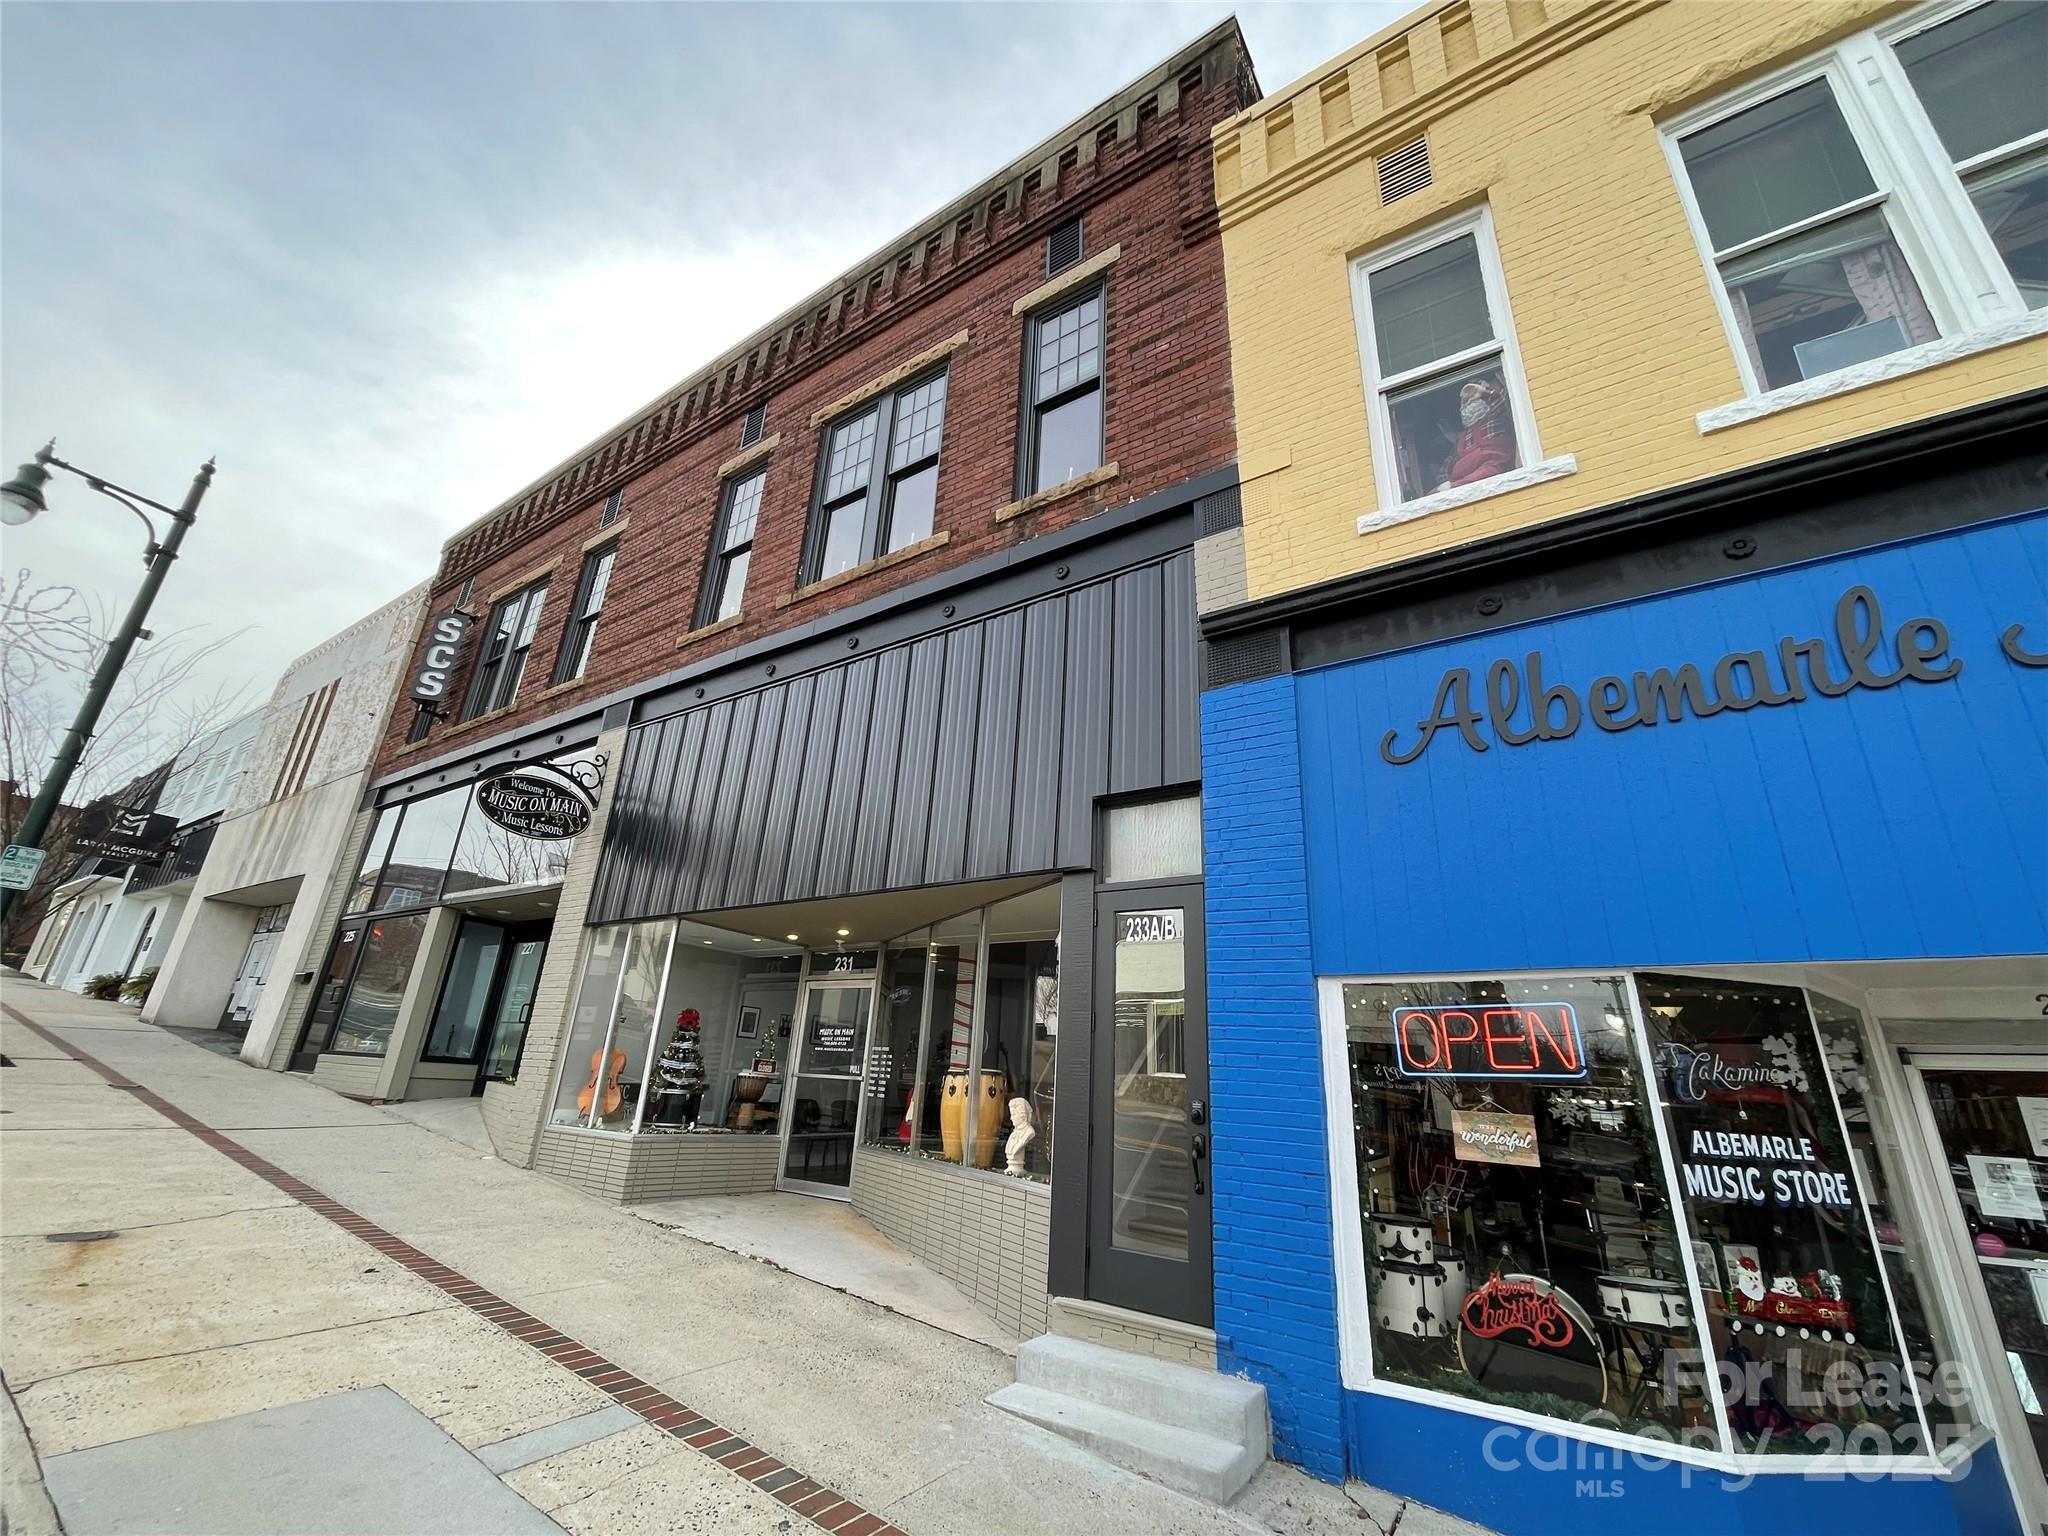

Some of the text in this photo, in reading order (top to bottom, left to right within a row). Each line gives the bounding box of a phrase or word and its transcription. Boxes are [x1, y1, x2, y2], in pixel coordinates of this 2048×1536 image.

[416, 617, 463, 695] SCS
[1381, 585, 1962, 764] Albemarle
[511, 778, 555, 797] Welcome To
[488, 789, 582, 817] MUSIC ON MAIN
[501, 811, 563, 836] Music Lessons
[5, 848, 17, 859] 2
[1126, 915, 1175, 942] 233A/B
[834, 956, 854, 971] 231
[1401, 1009, 1578, 1070] OPEN
[849, 1065, 860, 1074] PULL
[1460, 1127, 1532, 1152] wonderful
[1692, 1130, 1816, 1161] ALBEMARLE
[1682, 1164, 1852, 1205] MUSIC STORE
